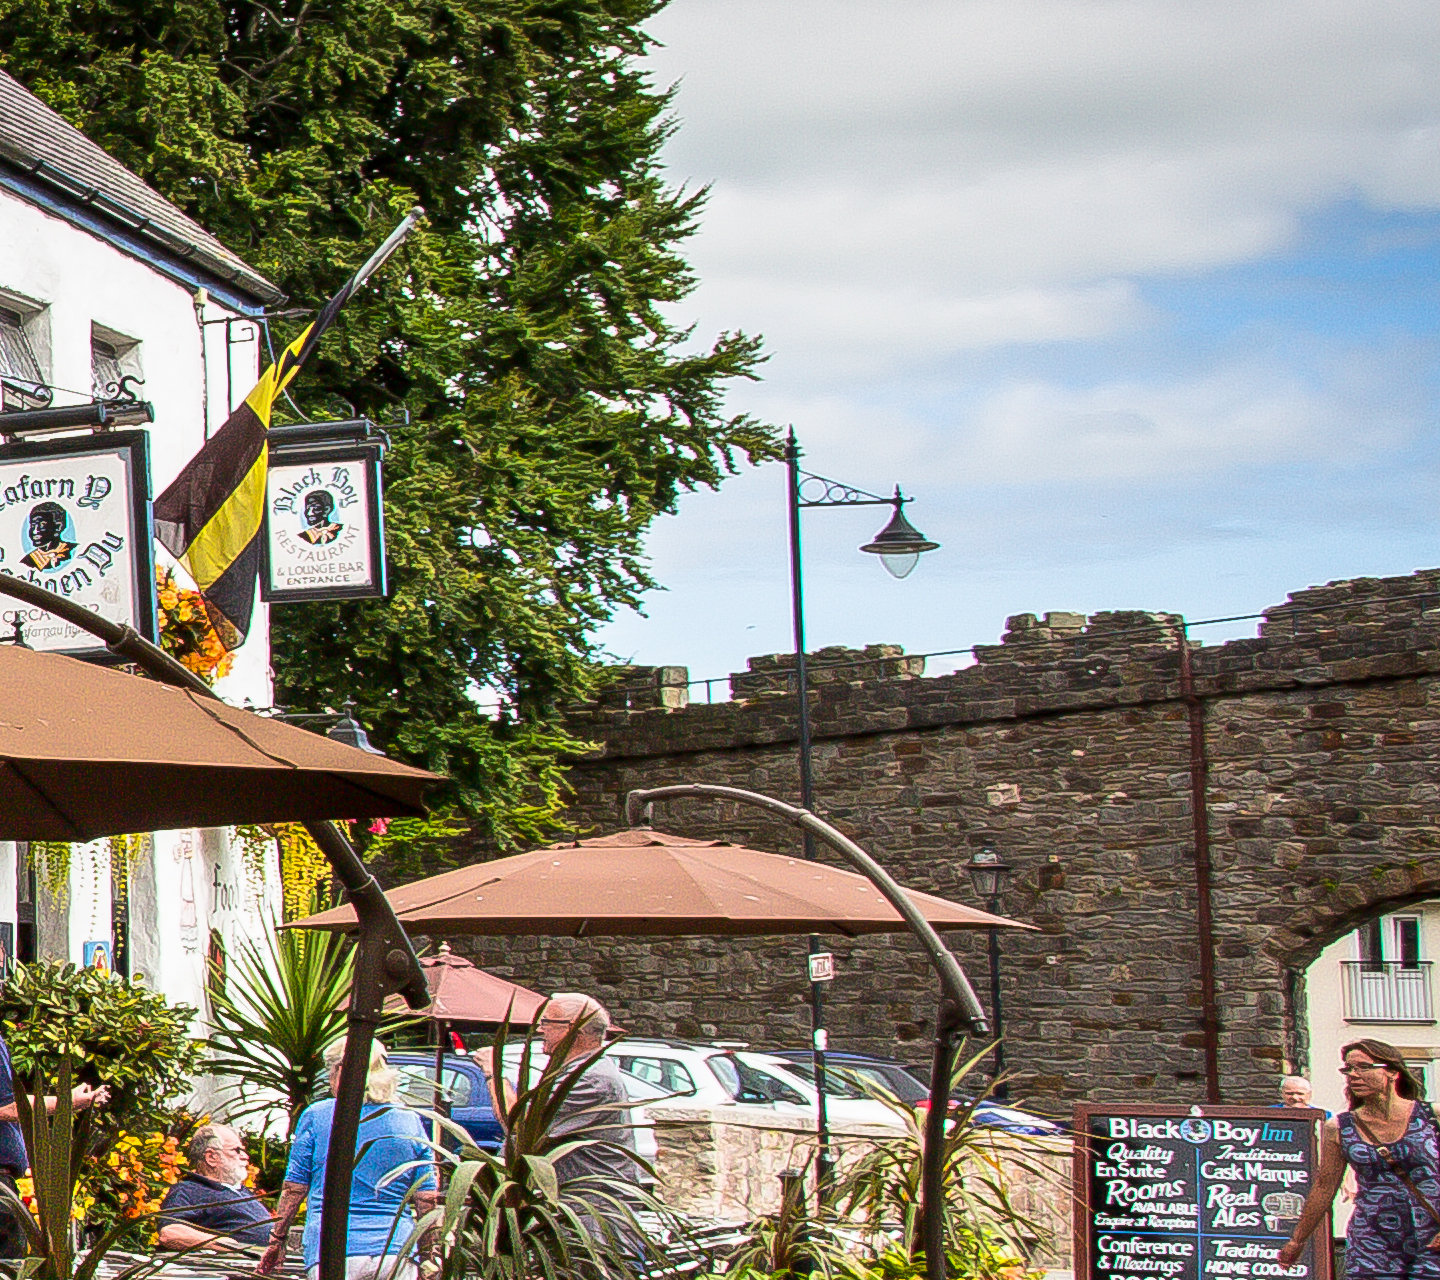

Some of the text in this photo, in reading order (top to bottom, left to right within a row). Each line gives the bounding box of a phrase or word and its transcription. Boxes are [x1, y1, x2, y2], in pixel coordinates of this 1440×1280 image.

[273, 466, 358, 516] Black Boy
[275, 524, 360, 561] RESTAURANT
[77, 531, 124, 577] Du
[288, 563, 336, 575] LOUNGE
[339, 561, 364, 573] BAR
[287, 574, 350, 586] ENTRANCE
[3, 609, 51, 624] CRCA
[1109, 1118, 1293, 1145] Black Boy Inn
[1107, 1142, 1174, 1164] Quality
[1215, 1145, 1305, 1162] Traditional
[1095, 1162, 1167, 1179] En Suite
[1200, 1161, 1309, 1187] Cask Marque
[1106, 1180, 1187, 1206] Rooms
[1206, 1184, 1259, 1208] Real
[1130, 1202, 1199, 1215] AVAILABLE
[1212, 1208, 1261, 1228] Ales
[1097, 1235, 1194, 1257] Conference
[1096, 1254, 1184, 1277] & Meetings
[1205, 1260, 1250, 1275] HOME
